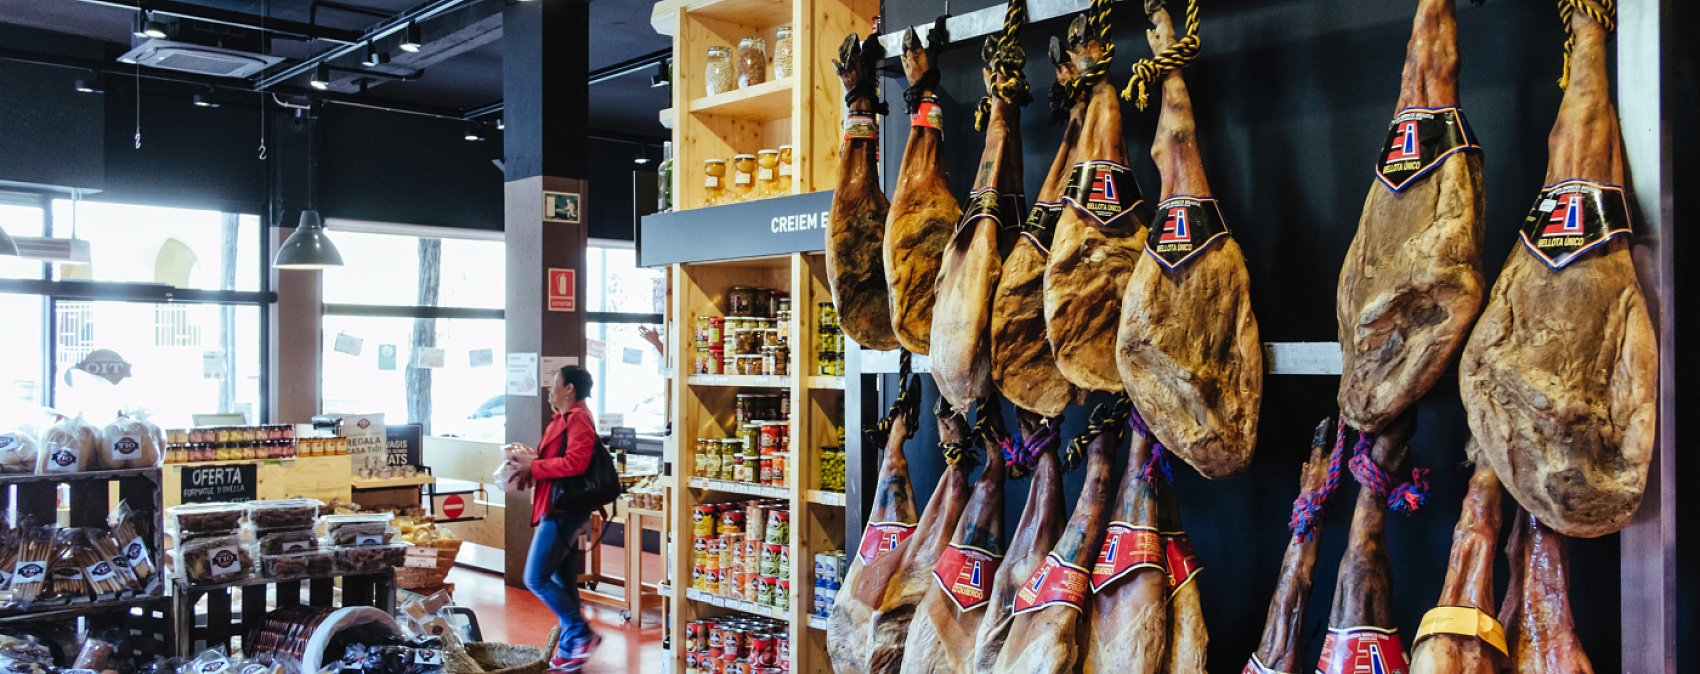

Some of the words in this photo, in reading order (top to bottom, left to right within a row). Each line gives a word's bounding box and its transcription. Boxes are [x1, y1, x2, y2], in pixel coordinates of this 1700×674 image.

[1383, 162, 1403, 174] BELLOTA
[1087, 202, 1107, 211] BELLOTA
[771, 212, 818, 233] CREIEM
[821, 211, 829, 228] E
[1537, 237, 1563, 248] BELLOTA
[1564, 236, 1584, 246] ÚNICO
[1157, 244, 1177, 253] BELLOTA
[347, 437, 381, 446] REGALA
[387, 453, 407, 465] ATS
[192, 467, 242, 486] OFERTA
